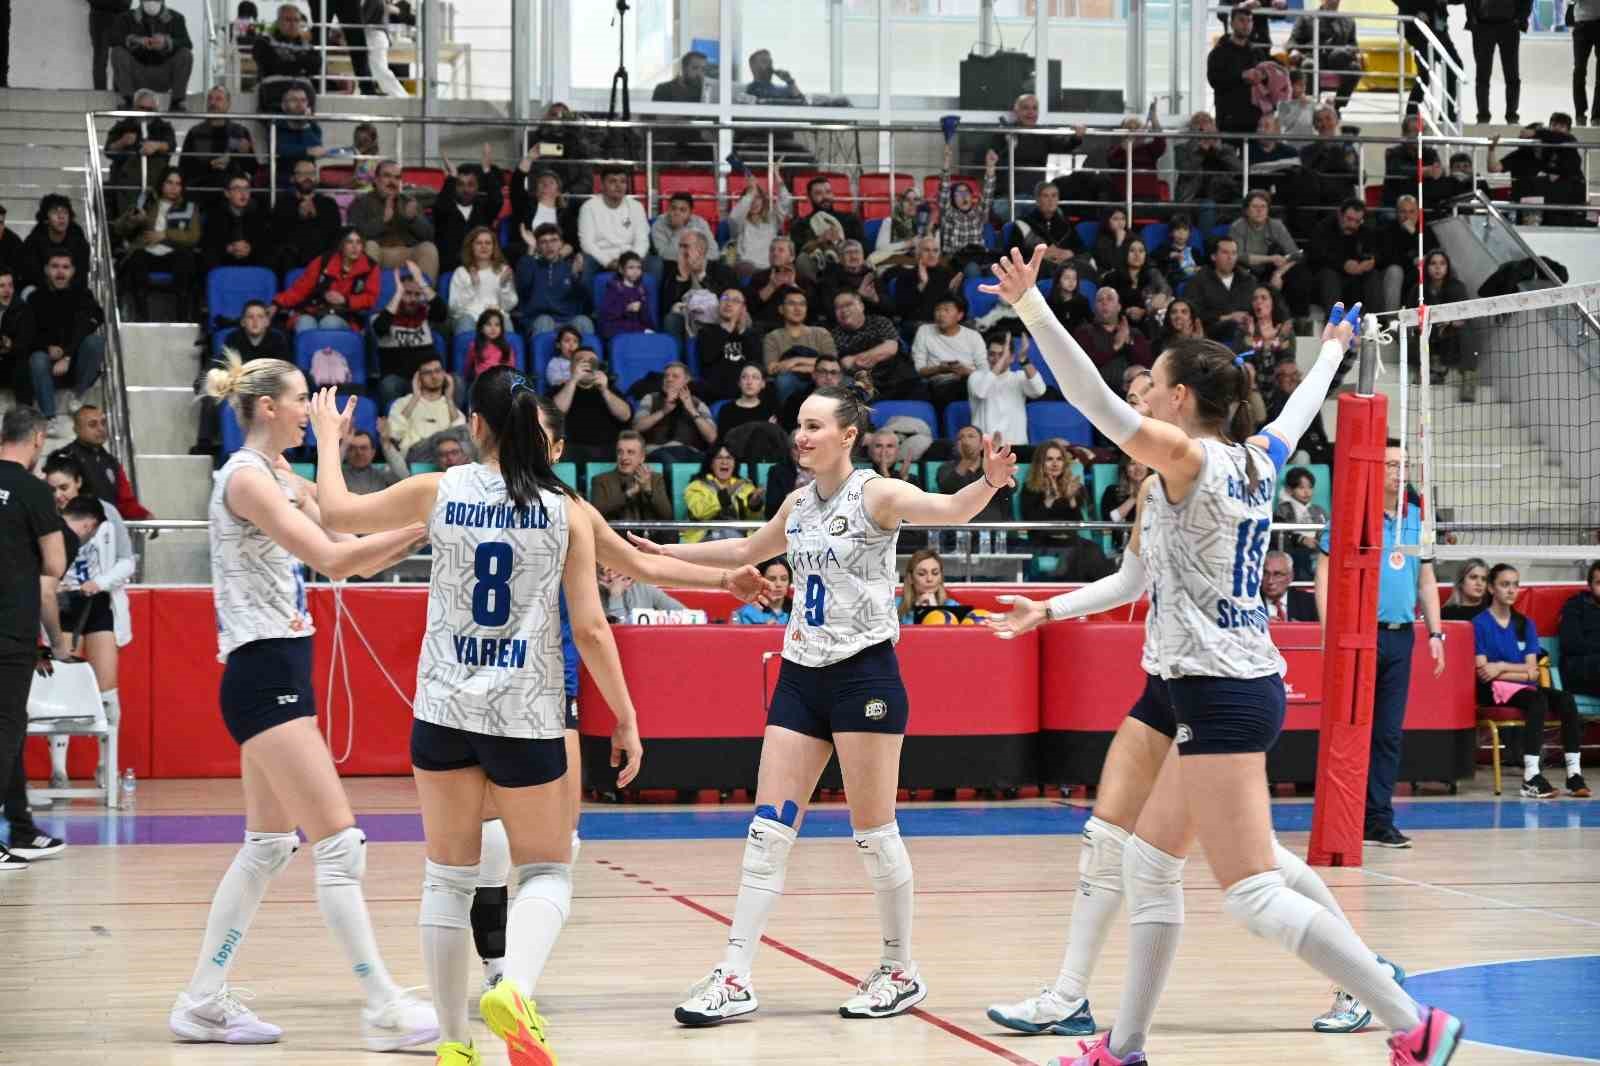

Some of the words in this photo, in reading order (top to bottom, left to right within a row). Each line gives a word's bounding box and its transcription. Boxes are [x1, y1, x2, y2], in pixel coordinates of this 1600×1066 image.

[445, 501, 516, 529] BOZÜYÜK
[472, 541, 514, 627] 8
[805, 574, 826, 627] 9
[453, 634, 528, 669] YAREN
[212, 927, 243, 968] friday
